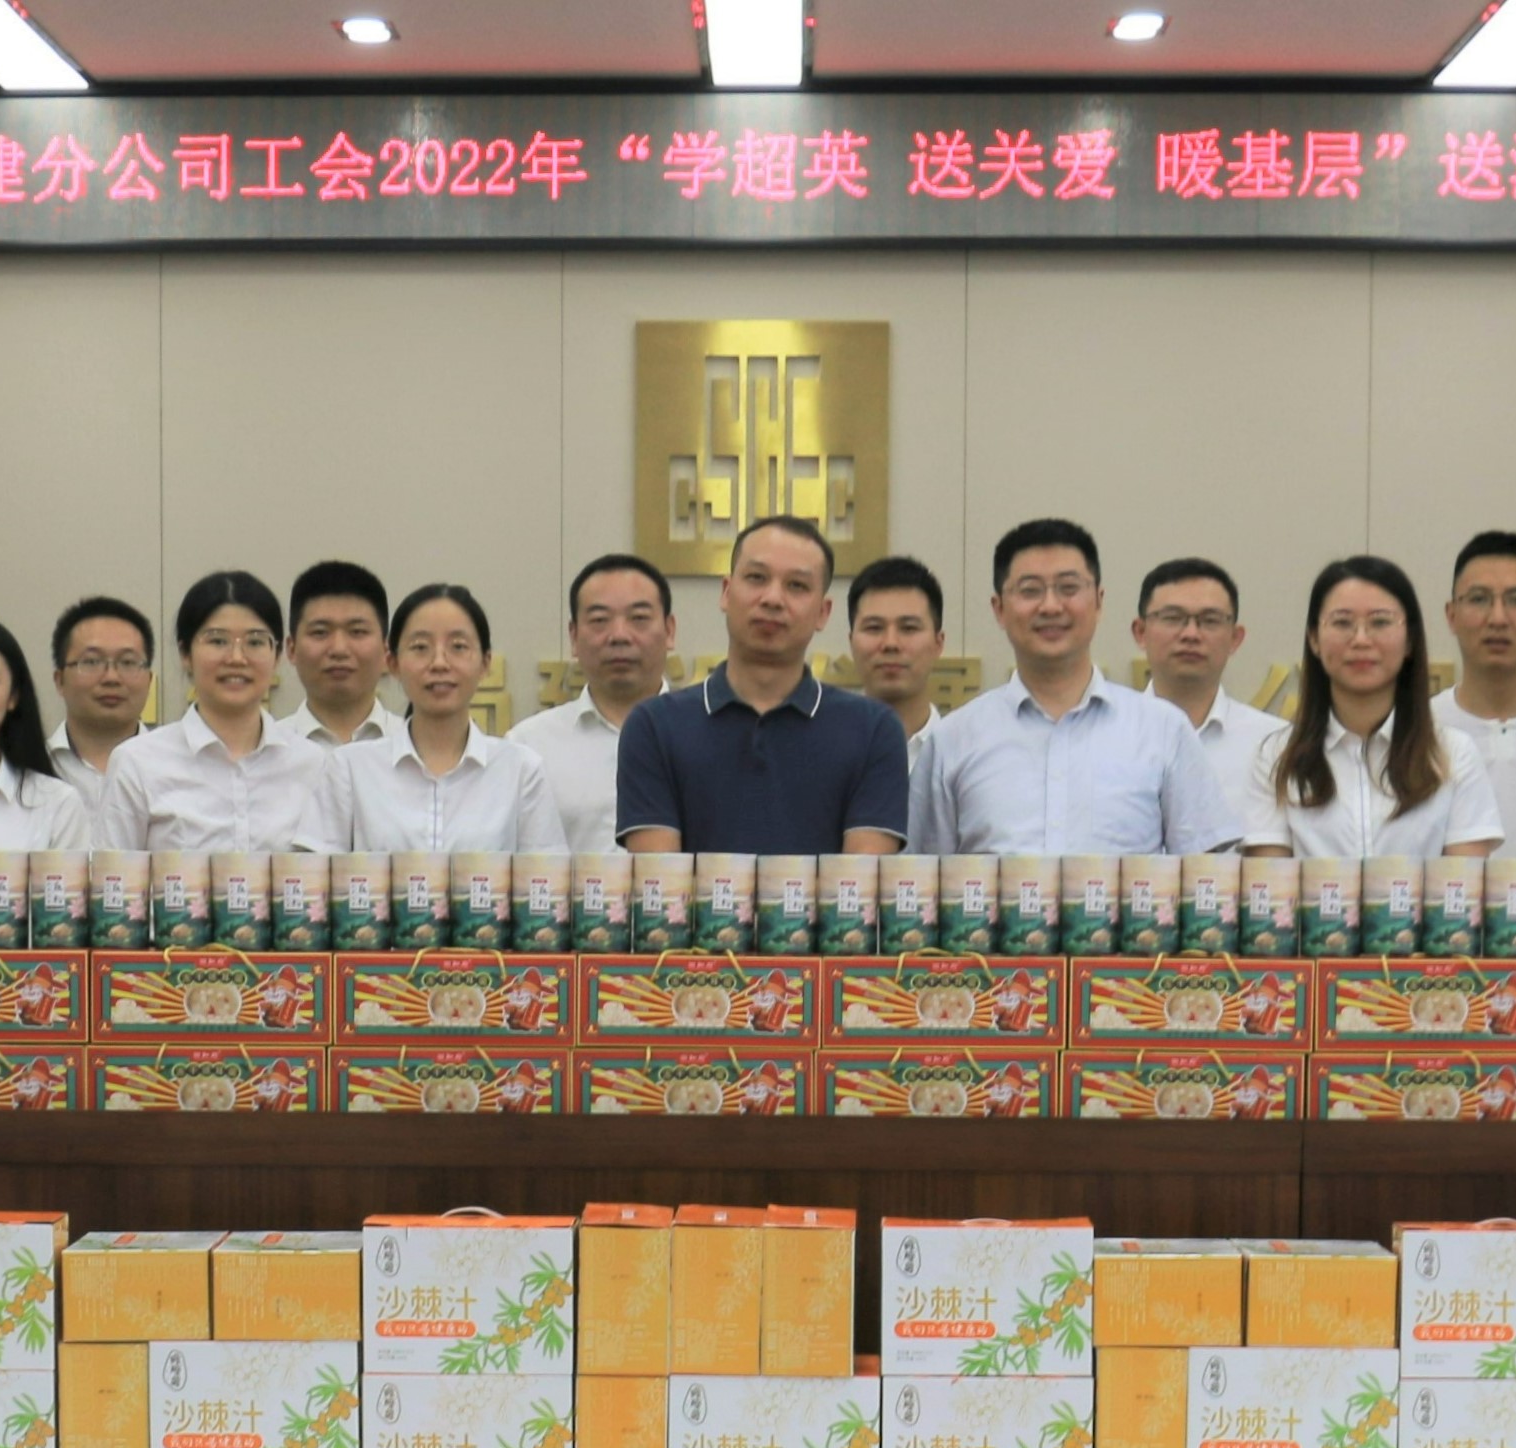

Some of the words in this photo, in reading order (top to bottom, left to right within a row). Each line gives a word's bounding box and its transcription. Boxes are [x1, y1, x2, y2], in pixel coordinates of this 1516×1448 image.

[908, 129, 1117, 201] 送关爱
[376, 1288, 476, 1321] 沙棘汁
[894, 1287, 996, 1323] 沙棘汁
[1414, 1292, 1514, 1326] 沙棘汁
[163, 1401, 262, 1435] 沙棘汁
[1200, 1408, 1300, 1442] 沙棘汁
